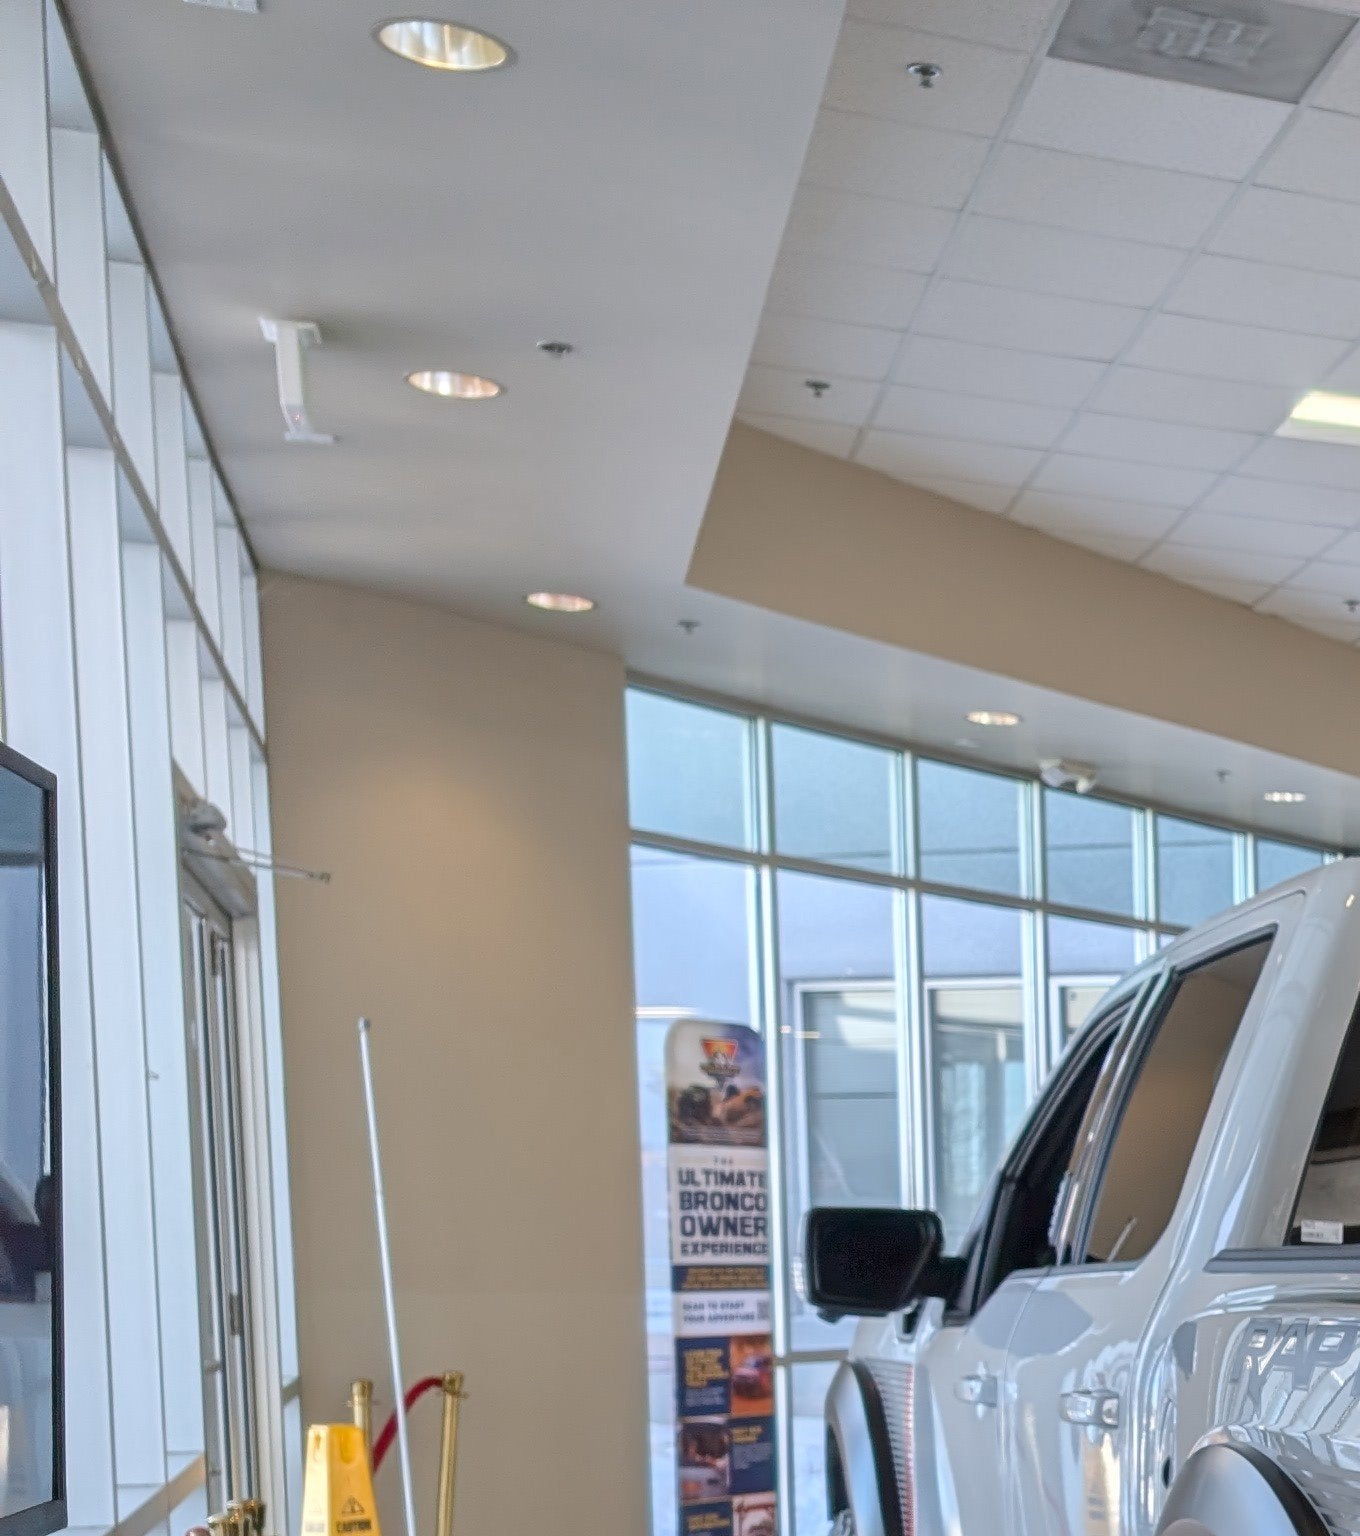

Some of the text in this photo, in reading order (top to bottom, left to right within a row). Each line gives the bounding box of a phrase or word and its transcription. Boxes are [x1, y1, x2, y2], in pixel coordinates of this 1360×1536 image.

[679, 1190, 767, 1212] BRONCO
[680, 1215, 768, 1237] OWNER
[680, 1242, 768, 1256] EXPERIENCE
